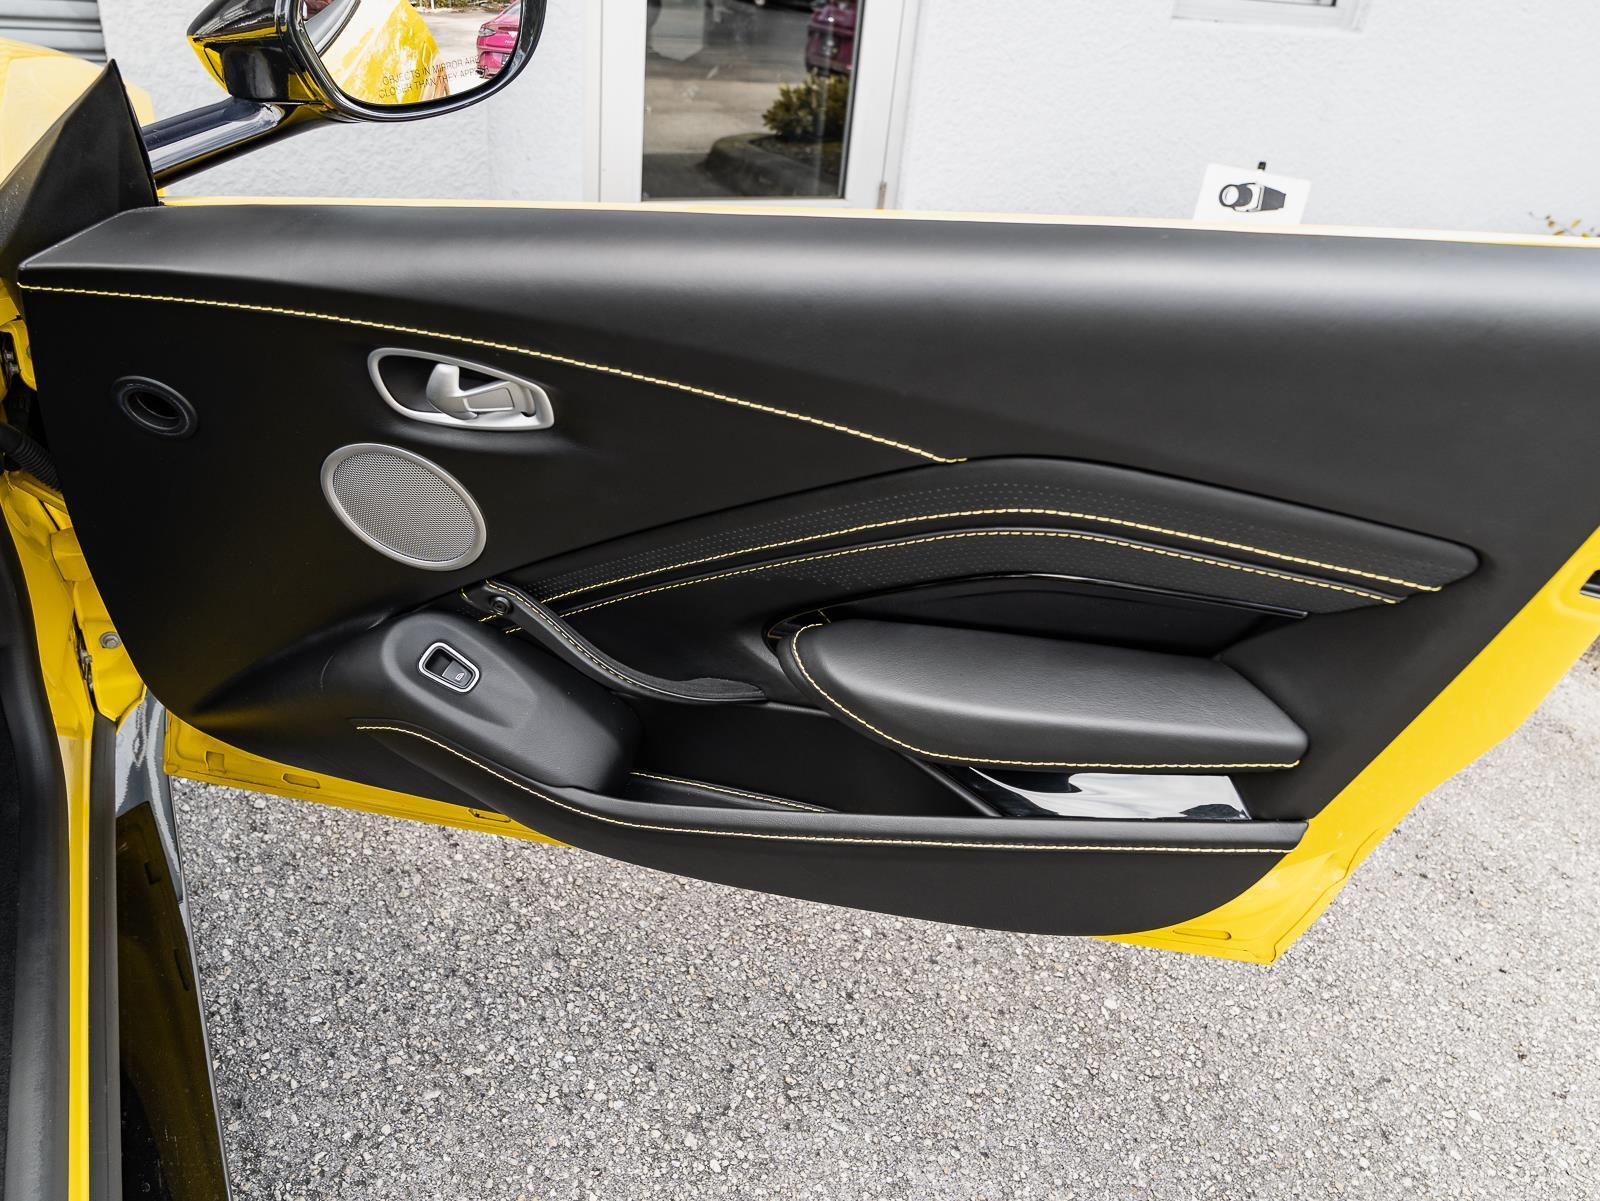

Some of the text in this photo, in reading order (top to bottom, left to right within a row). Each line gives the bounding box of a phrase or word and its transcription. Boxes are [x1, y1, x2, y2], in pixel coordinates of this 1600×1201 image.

[379, 84, 412, 99] CLOSER
[414, 78, 437, 90] THAN
[437, 71, 457, 83] THEY
[383, 55, 481, 86] OBJECTS IN MIRROR ARE
